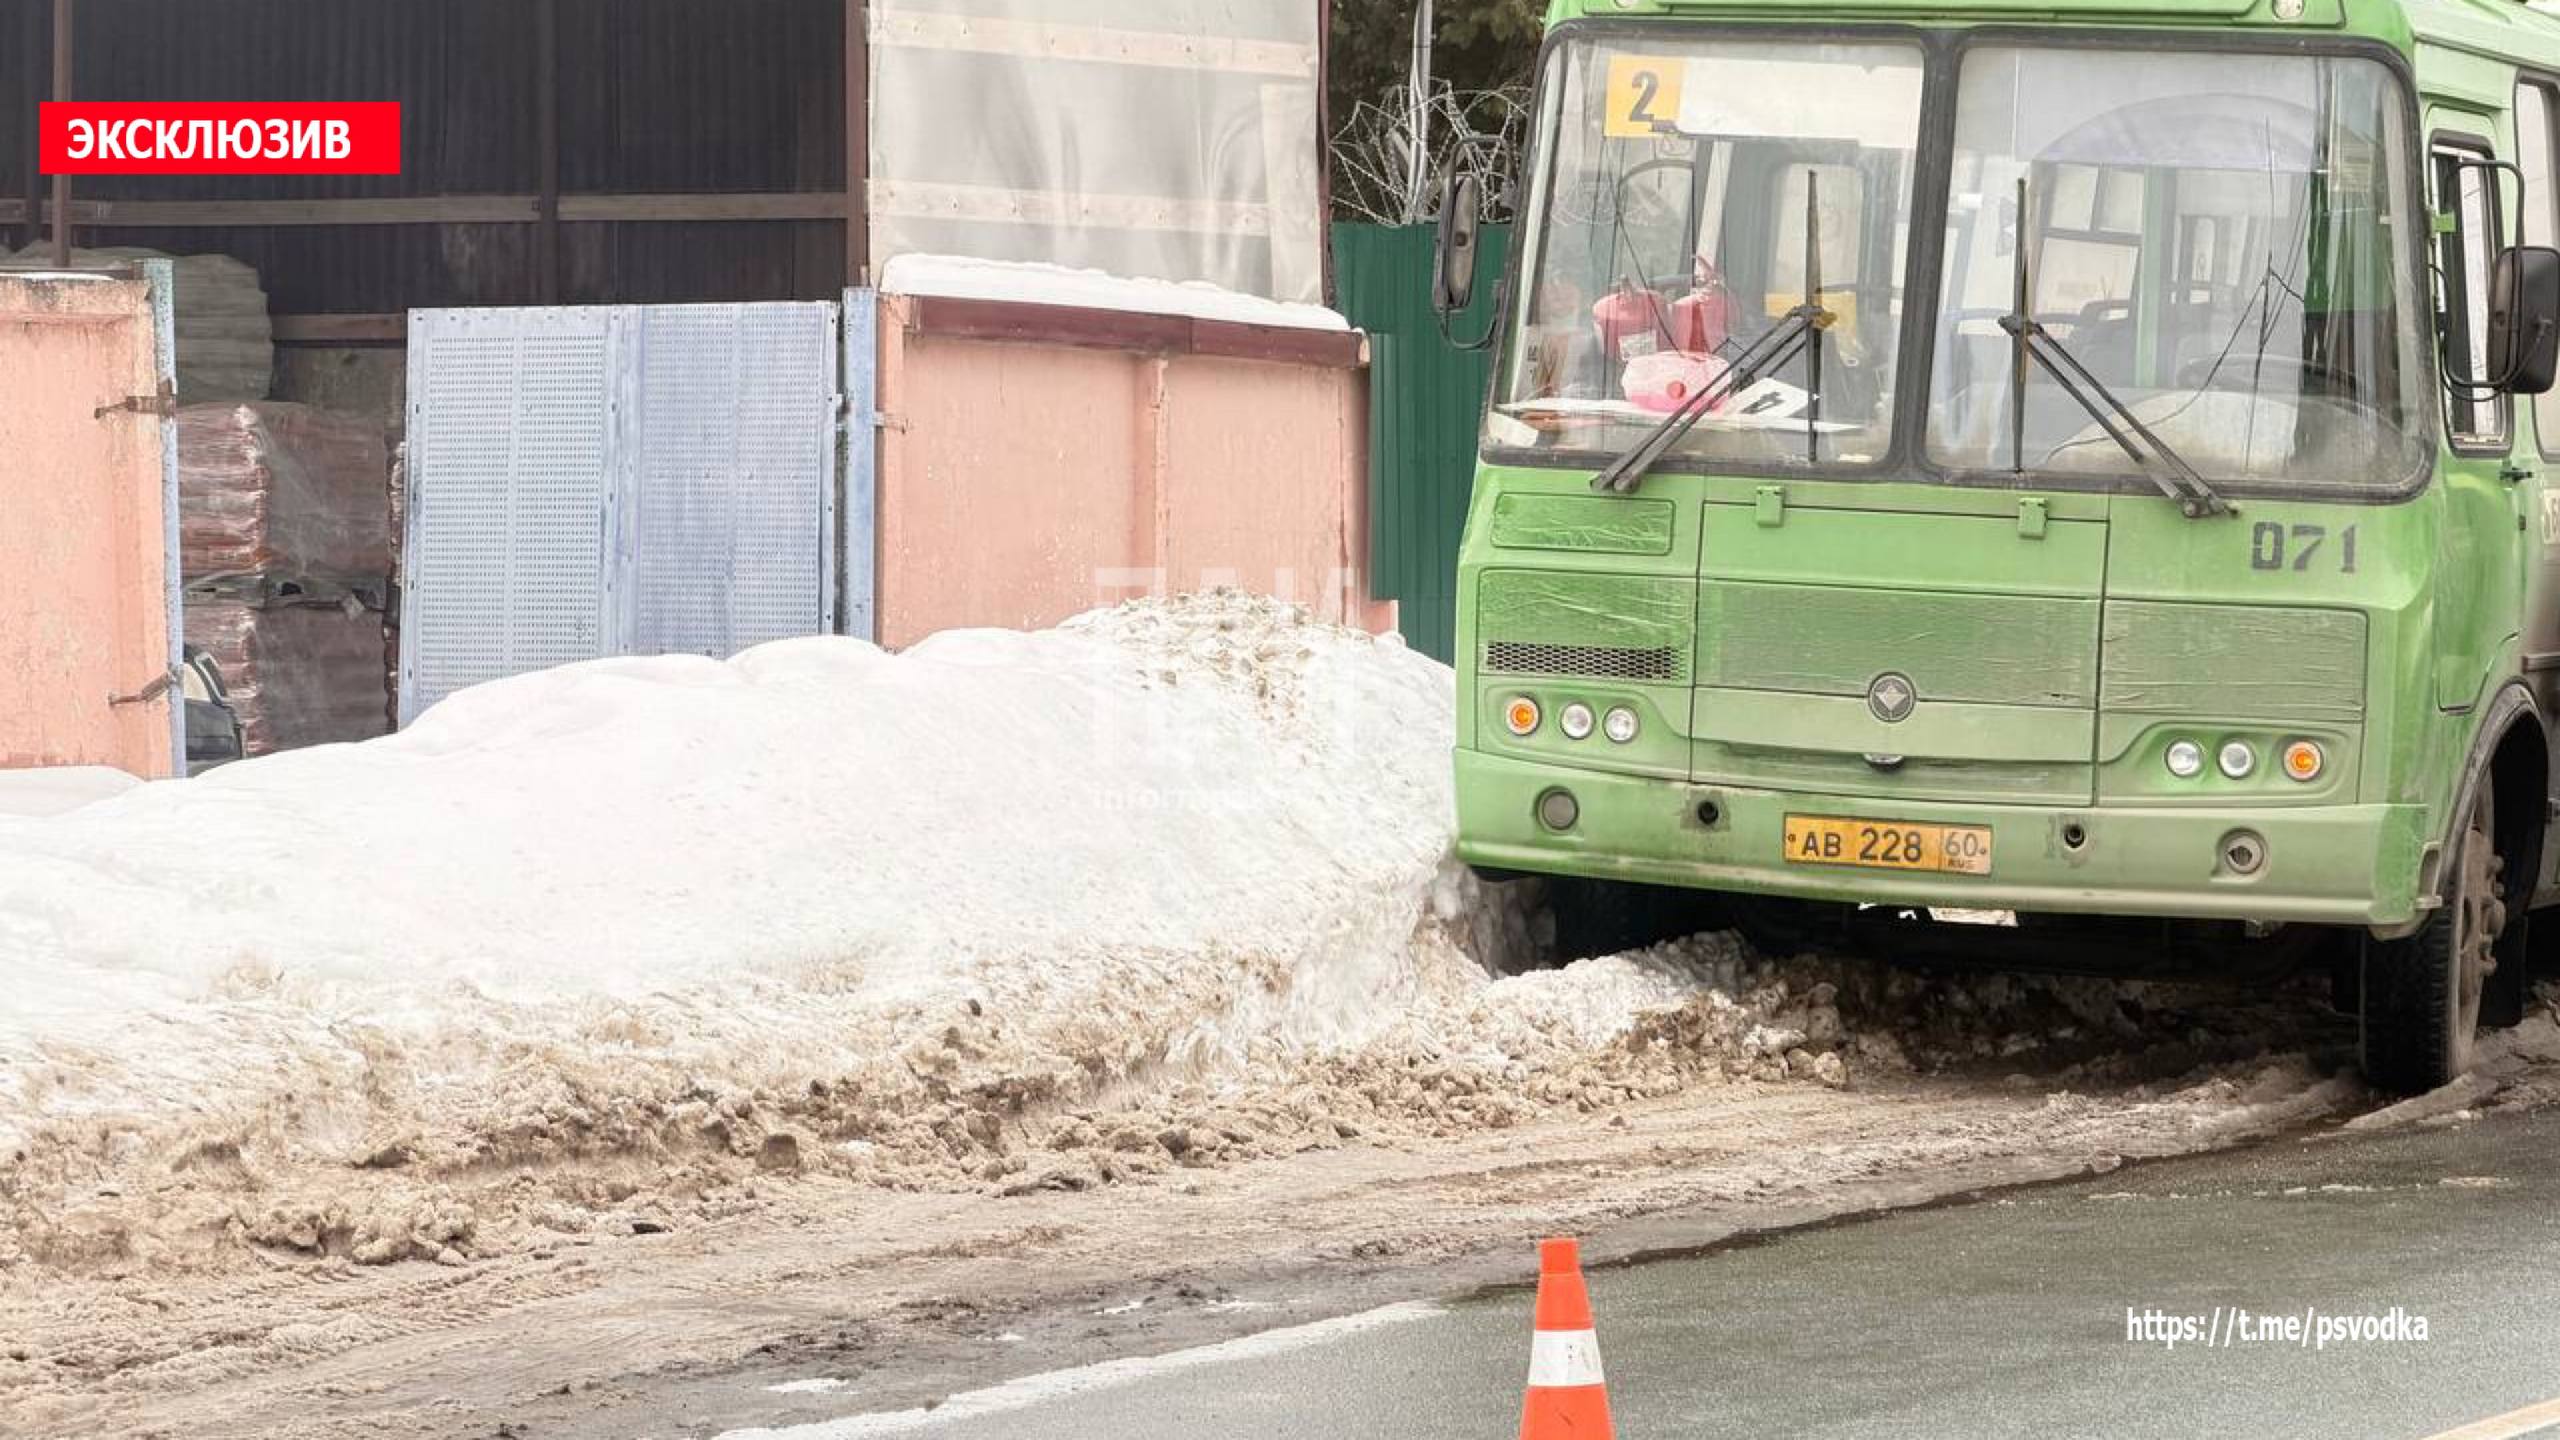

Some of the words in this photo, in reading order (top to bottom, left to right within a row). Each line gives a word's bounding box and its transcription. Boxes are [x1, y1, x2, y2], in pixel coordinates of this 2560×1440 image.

[1629, 69, 1659, 122] 2
[2252, 521, 2357, 574] 071
[1859, 827, 1923, 863] 228
[1945, 831, 1979, 857] 60
